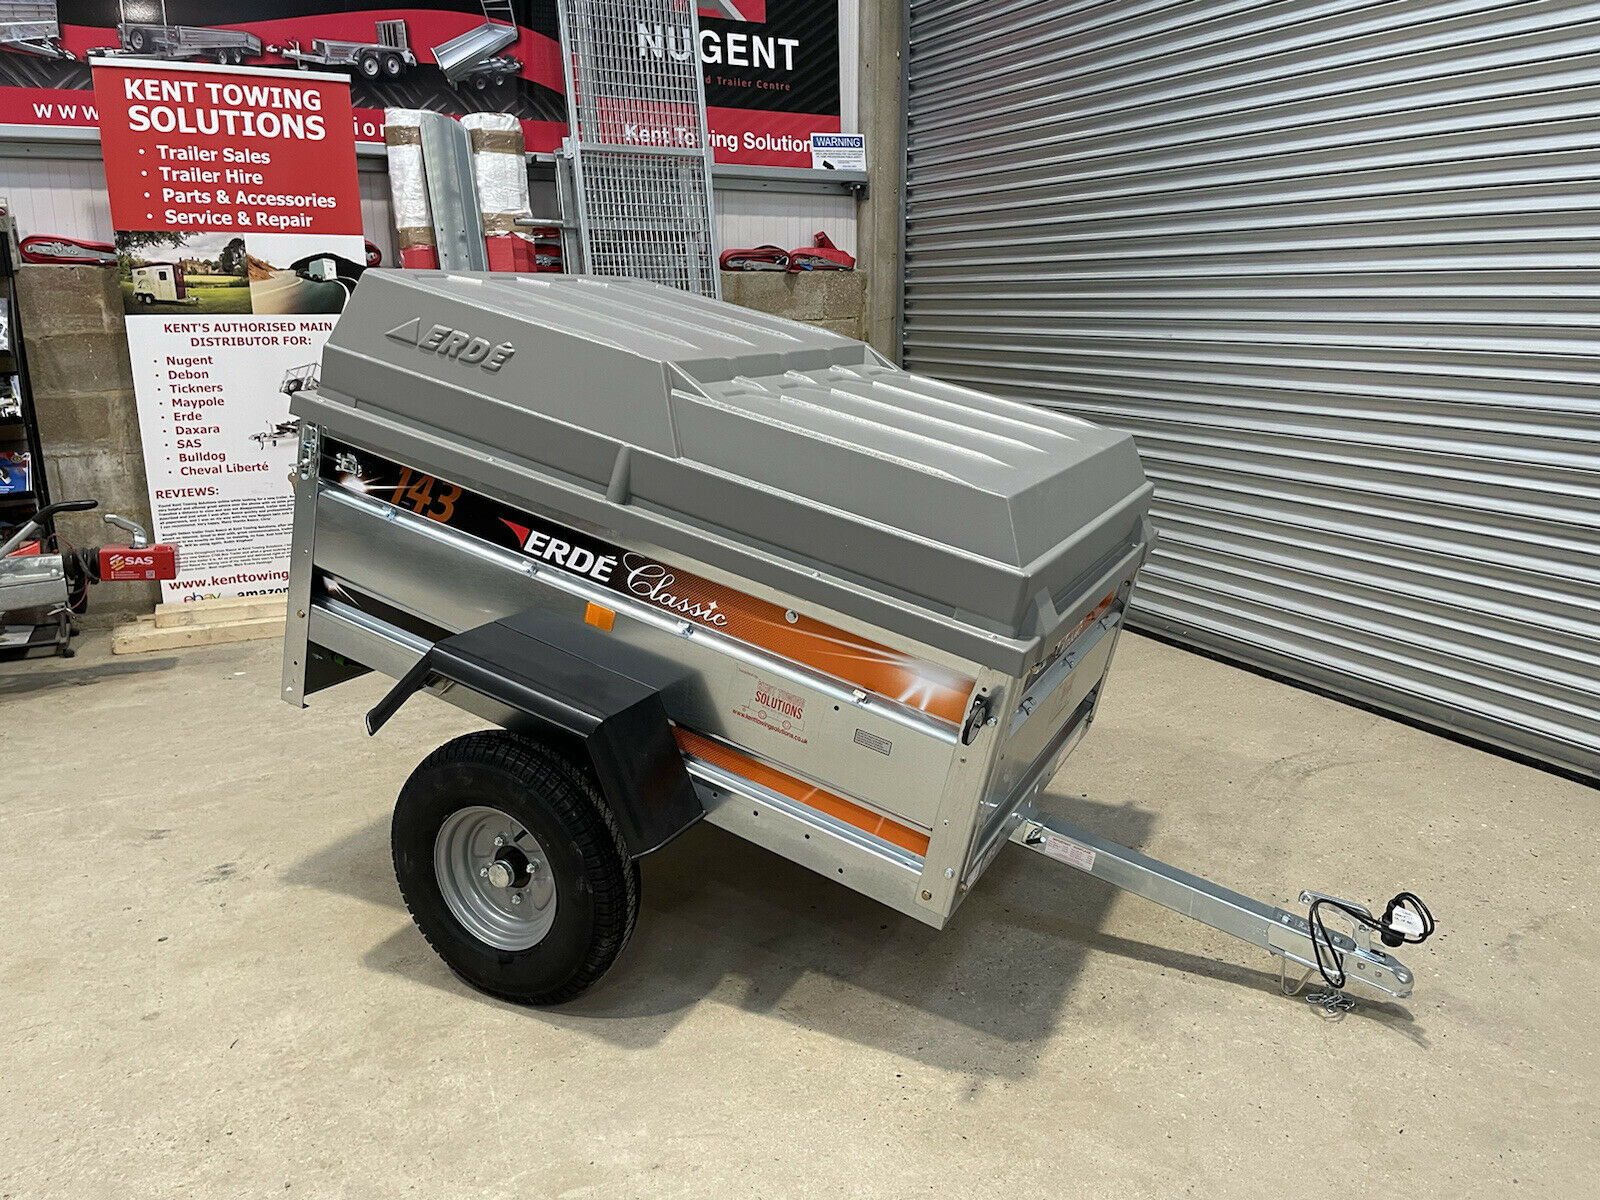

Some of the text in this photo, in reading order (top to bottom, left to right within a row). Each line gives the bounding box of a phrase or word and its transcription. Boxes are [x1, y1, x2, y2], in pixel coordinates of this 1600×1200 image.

[637, 21, 799, 71] NUGENT
[717, 76, 752, 89] Trailer
[756, 79, 791, 91] Centre
[124, 78, 321, 111] KENT TOWING
[128, 104, 326, 140] SOLUTIONS
[625, 124, 670, 145] Kent
[815, 137, 861, 147] WARNING
[156, 144, 271, 164] Trailer Sales
[159, 166, 263, 185] Trailer Hire
[162, 188, 337, 208] Parts & Accessories
[164, 210, 313, 230] Service & Repair
[164, 322, 333, 334] KENT'S AUTHORISED MAIN
[190, 335, 312, 347] DISTRIBUTOR FOR:
[166, 355, 214, 368] Nugent
[168, 369, 209, 380] Debon
[169, 383, 223, 394] Tickners
[172, 397, 225, 409] Maypole
[173, 411, 202, 422] Erde
[176, 424, 220, 435] Daxara
[177, 439, 202, 449] SAS
[179, 452, 226, 464] Bulldog
[180, 462, 269, 476] Cheval Liberté
[155, 487, 219, 499] REVIEWS:
[390, 466, 462, 523] 143
[125, 556, 154, 565] SAS
[168, 571, 289, 590] www.kenttowing
[523, 530, 728, 627] ERDÉ Classic
[754, 690, 803, 720] SOLUTIONS
